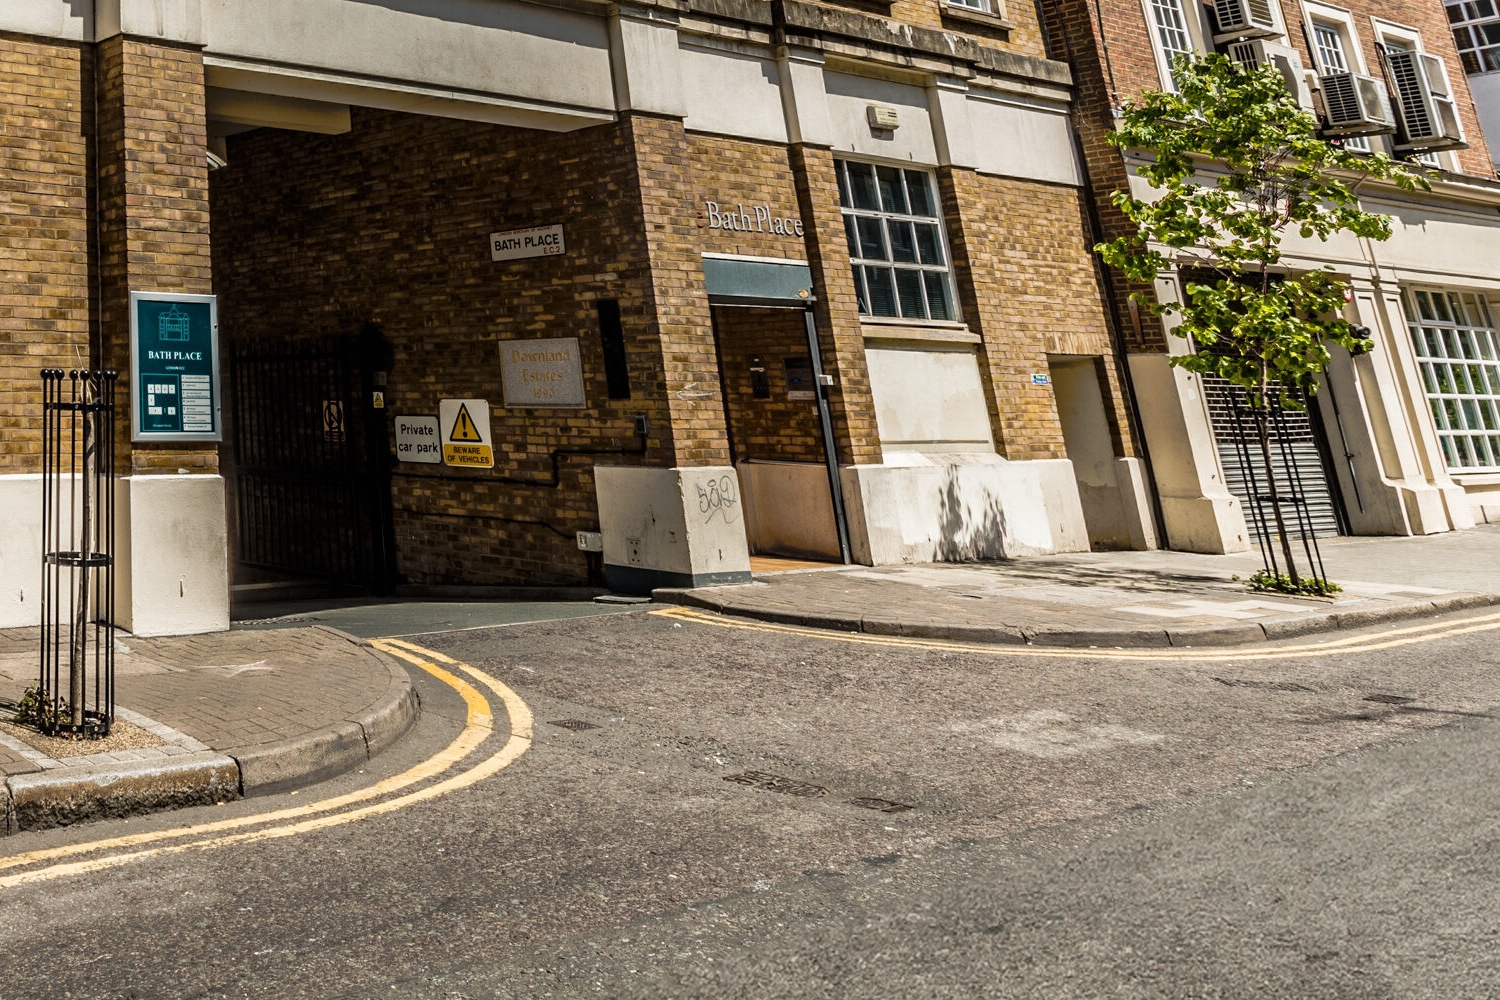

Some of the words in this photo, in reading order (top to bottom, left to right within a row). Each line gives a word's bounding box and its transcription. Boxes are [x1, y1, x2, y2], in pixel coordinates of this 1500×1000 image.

[705, 201, 754, 232] Bath
[752, 205, 805, 237] Place
[495, 239, 521, 251] BATH
[524, 233, 560, 248] PLACE
[148, 350, 172, 360] BATH
[174, 352, 202, 360] PLACE
[511, 349, 570, 363] Downland
[521, 368, 563, 382] Estates
[400, 424, 434, 435] Private
[398, 443, 413, 452] car
[416, 443, 439, 455] park
[453, 446, 481, 455] BEWARE
[447, 455, 456, 463] OF
[458, 456, 490, 464] VEHICLES
